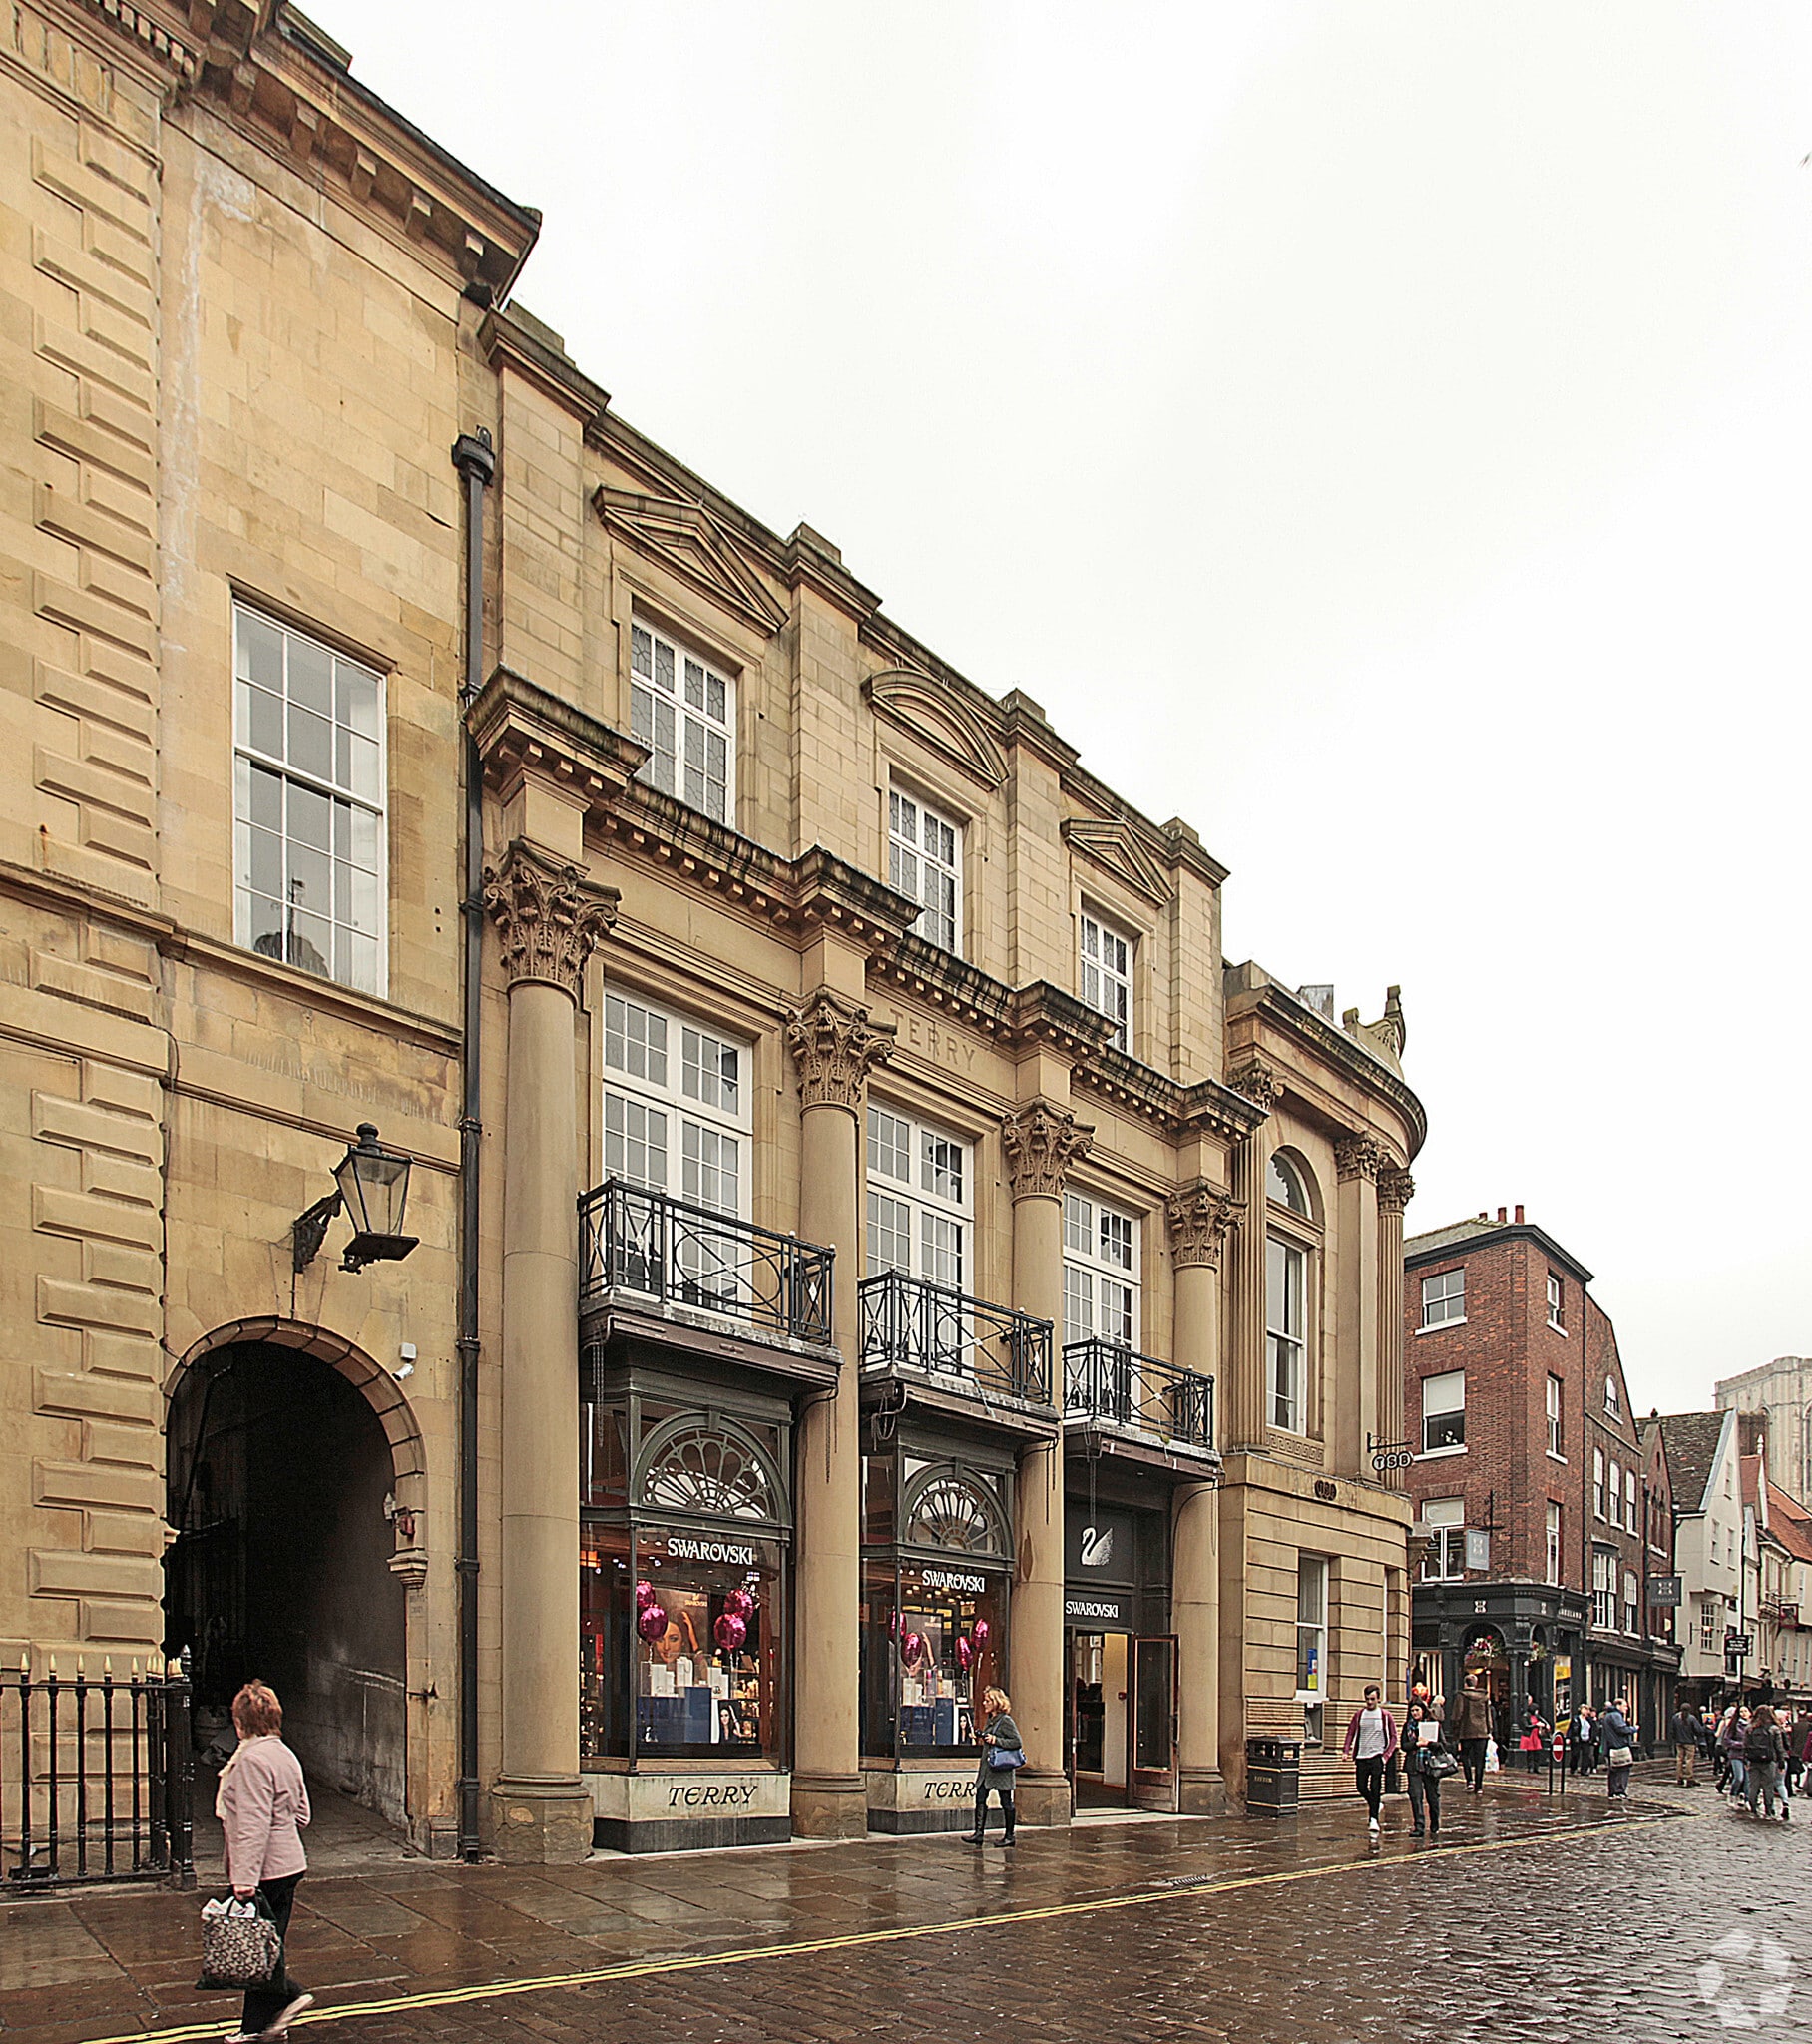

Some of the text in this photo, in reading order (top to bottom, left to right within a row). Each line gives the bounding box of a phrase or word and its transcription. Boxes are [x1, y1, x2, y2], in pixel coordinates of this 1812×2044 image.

[890, 1008, 975, 1071] TERRY
[1372, 1451, 1413, 1471] TSB
[667, 1538, 753, 1565] SWAROVSKI
[922, 1570, 985, 1593] SWAROVSKI
[1066, 1601, 1119, 1618] SWAROVSKI
[669, 1785, 758, 1806] TERRY
[924, 1782, 977, 1799] TERR
